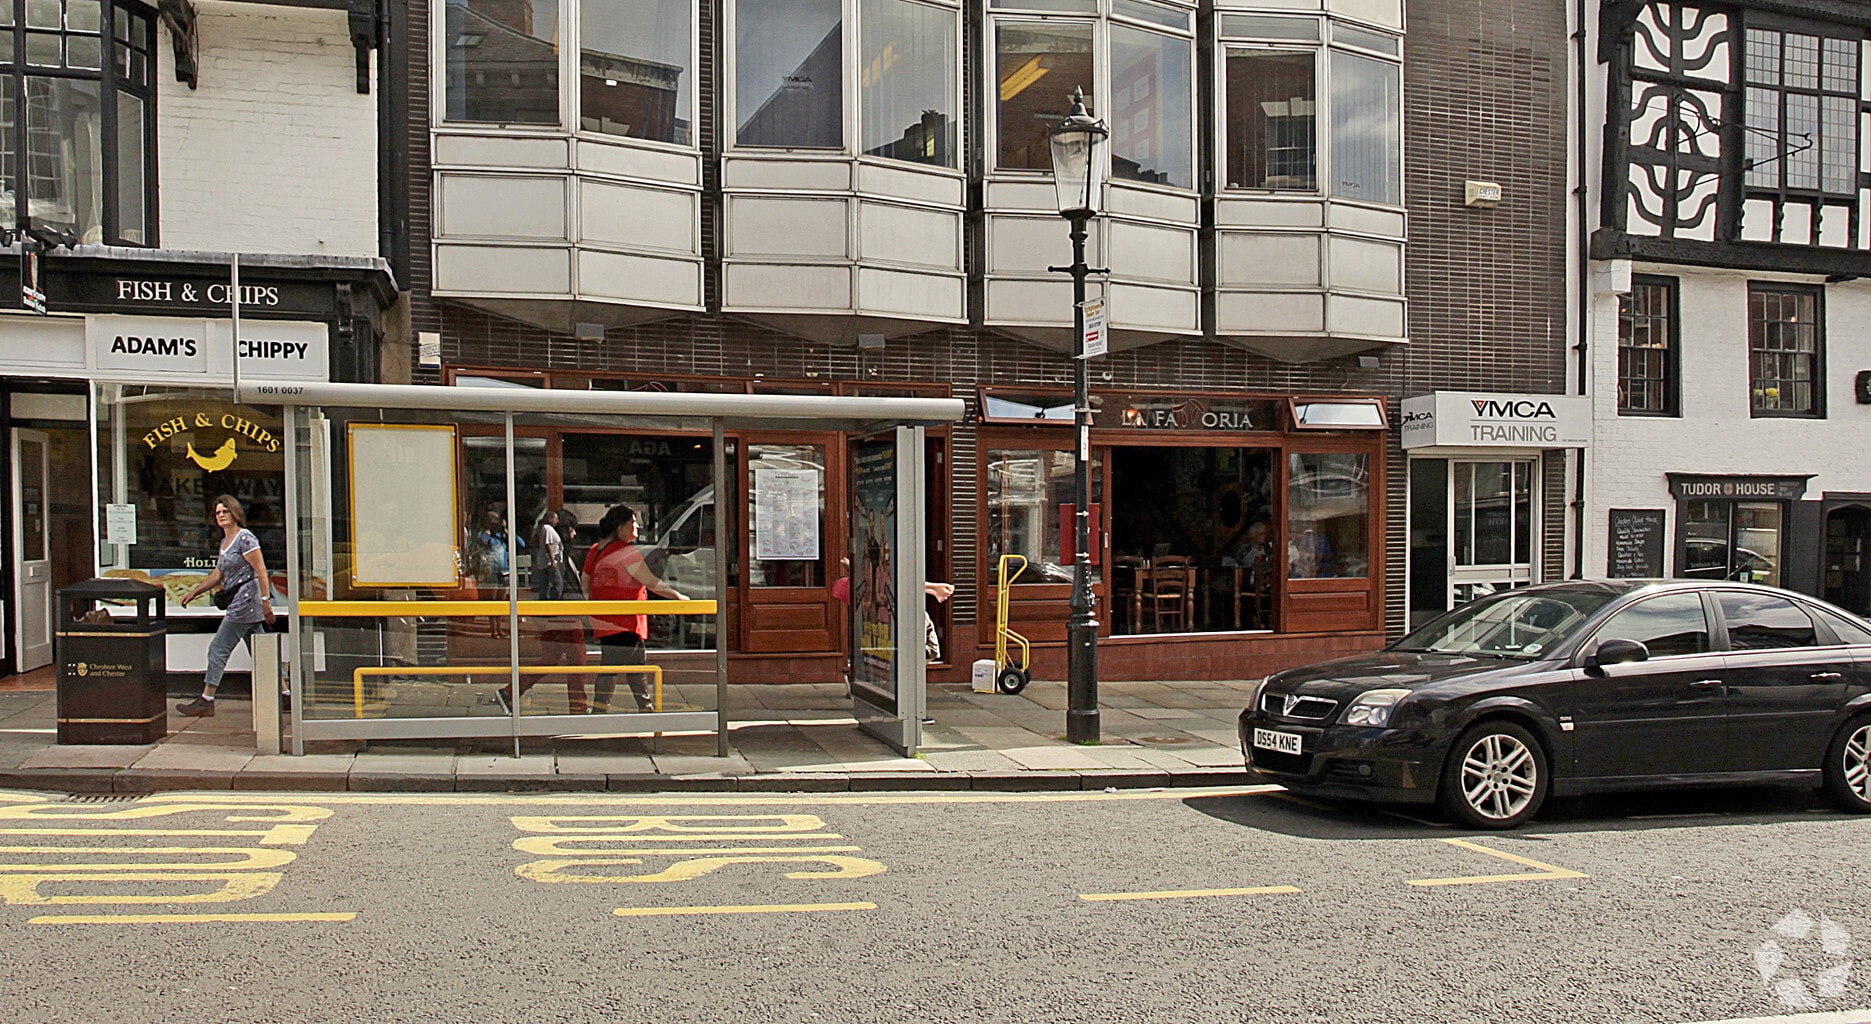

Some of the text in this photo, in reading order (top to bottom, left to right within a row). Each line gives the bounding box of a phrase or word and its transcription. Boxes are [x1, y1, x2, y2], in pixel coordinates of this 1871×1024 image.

[117, 280, 279, 306] FISH & CHIPS
[111, 336, 308, 360] ADAM'S CHIPPY
[257, 386, 304, 395] 1601 0037
[1471, 400, 1556, 418] YMCA
[142, 412, 280, 453] FISH & CHIPS
[1471, 425, 1557, 442] TRAINING
[1681, 483, 1775, 495] TUDOR HOUSE
[1257, 730, 1298, 752] DS54 KNE
[510, 814, 888, 883] BUS
